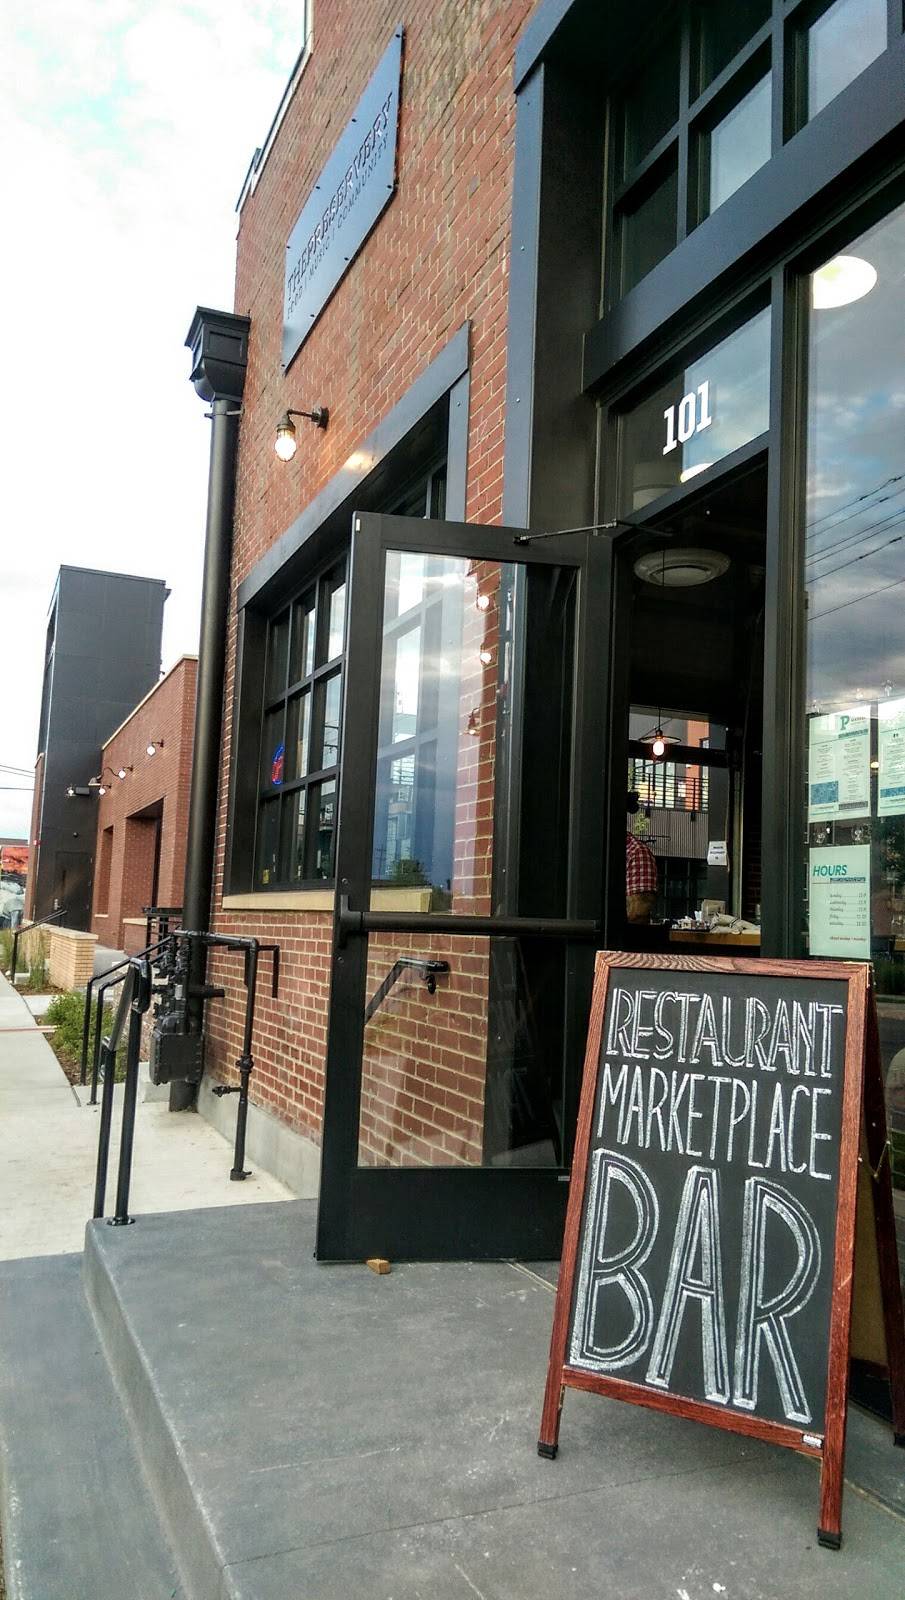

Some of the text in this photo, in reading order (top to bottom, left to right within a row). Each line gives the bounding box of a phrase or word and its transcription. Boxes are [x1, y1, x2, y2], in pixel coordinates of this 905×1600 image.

[308, 236, 331, 281] MUSIC
[338, 132, 388, 229] COMMUNITY
[662, 380, 712, 456] 101
[812, 864, 848, 877] HOURS
[606, 987, 843, 1079] RESTAURANT
[597, 1062, 832, 1180] MARKETPLACE
[570, 1147, 822, 1424] BAR
